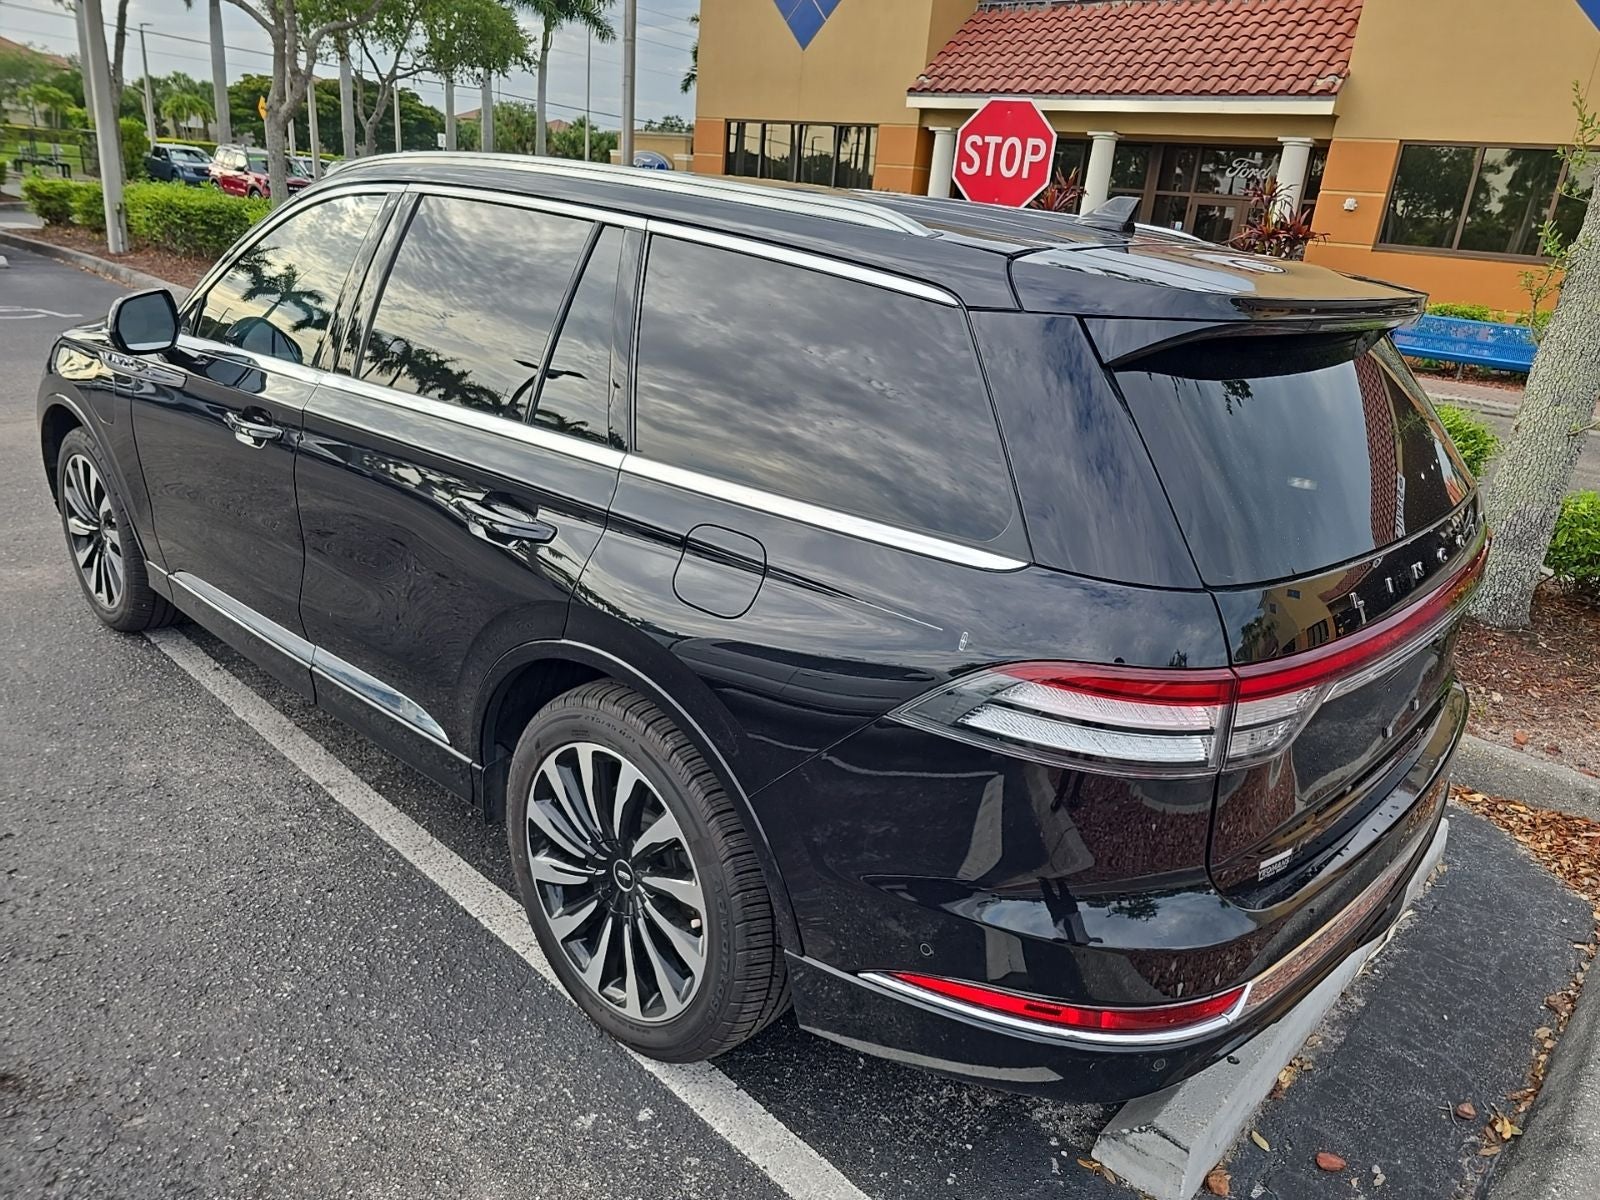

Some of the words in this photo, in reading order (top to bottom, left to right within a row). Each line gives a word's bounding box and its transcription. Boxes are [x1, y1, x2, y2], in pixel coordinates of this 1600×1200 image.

[961, 134, 1047, 179] STOP
[1225, 157, 1273, 179] Ford
[1349, 511, 1483, 609] LINCOL
